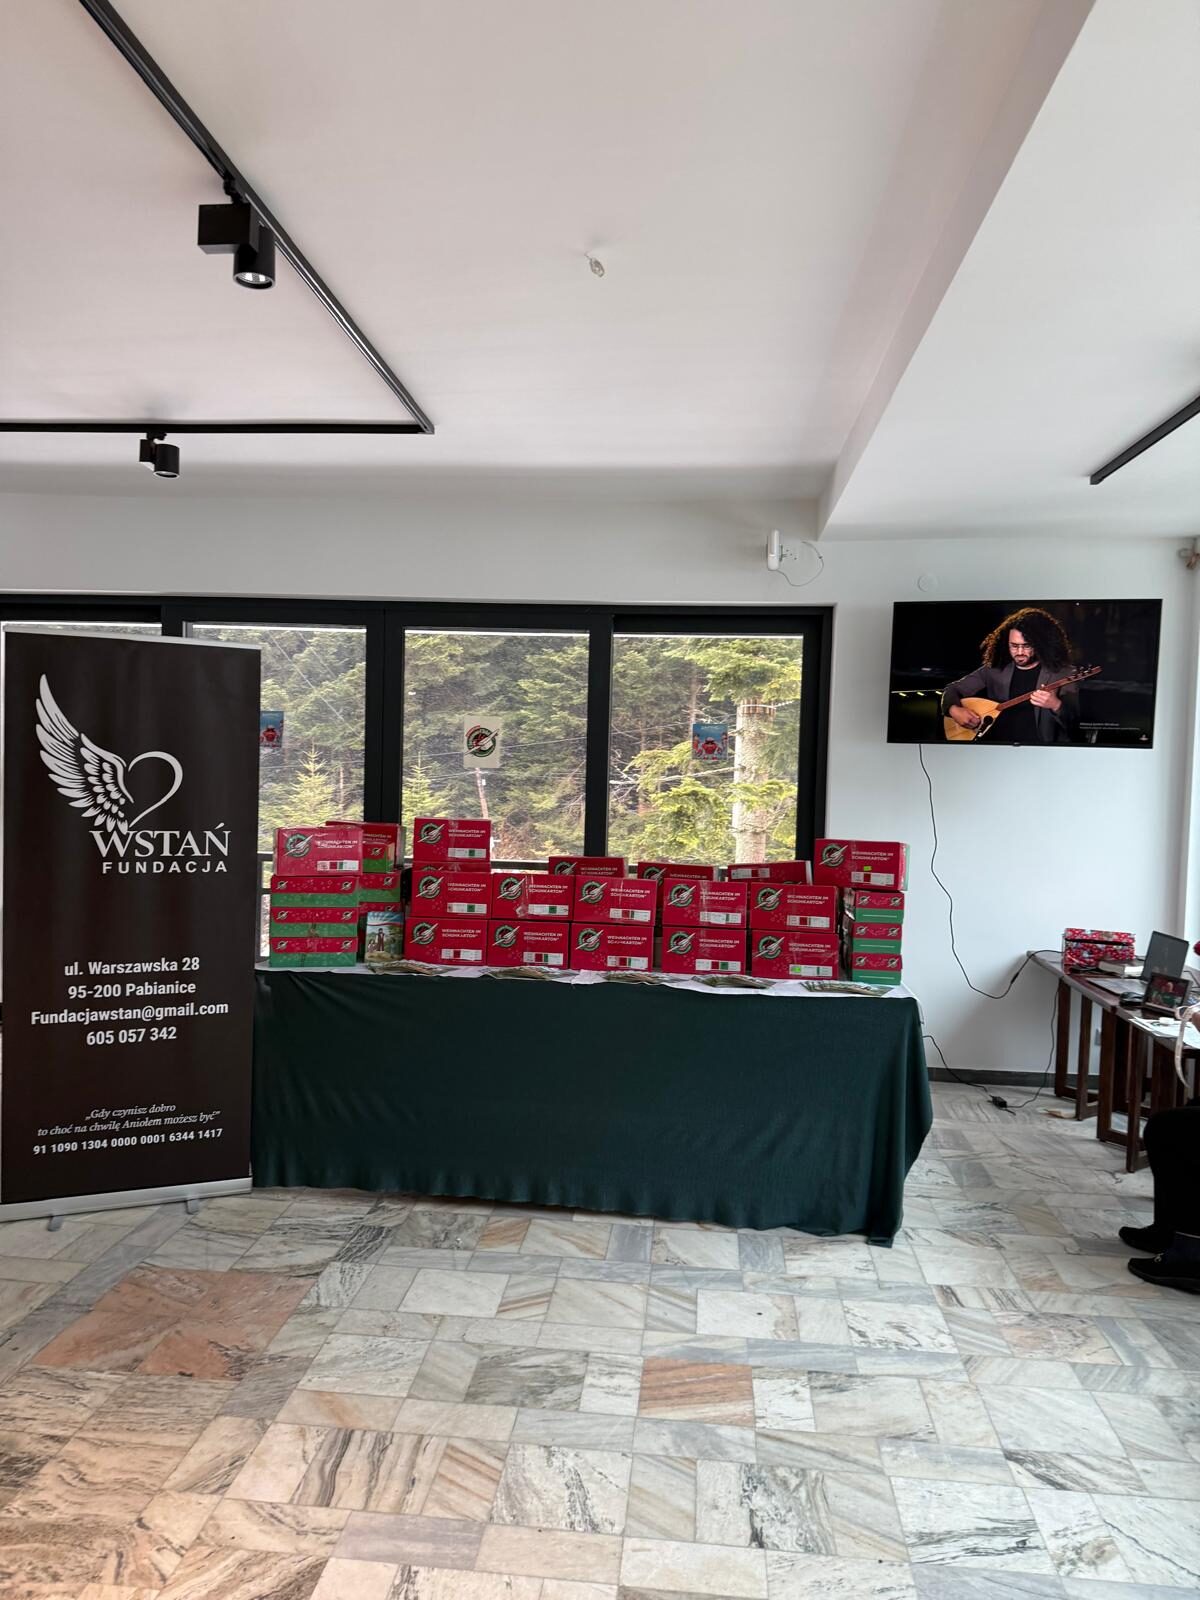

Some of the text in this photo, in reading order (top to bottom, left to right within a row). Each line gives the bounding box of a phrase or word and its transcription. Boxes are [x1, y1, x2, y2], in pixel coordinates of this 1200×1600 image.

[89, 822, 231, 857] WSTAŃ
[103, 861, 227, 873] FUNDACJA
[65, 957, 199, 976] ul. Warszawska 28
[68, 981, 196, 999] 95-200 Pabianice
[32, 1002, 228, 1025] Fundacjawstan@gmail.com
[87, 1027, 176, 1045] 605 057 342
[112, 1106, 148, 1119] czynisz
[149, 1104, 176, 1113] dobro
[50, 1124, 73, 1135] choć
[89, 1121, 121, 1132] chwilę
[122, 1118, 162, 1128] Aniołem
[164, 1114, 197, 1124] możesz
[33, 1145, 46, 1154] 91
[51, 1142, 77, 1152] 1090
[81, 1139, 108, 1150] 1304
[111, 1137, 137, 1147] 0000
[141, 1134, 165, 1144] 0001
[169, 1131, 194, 1141] 6344
